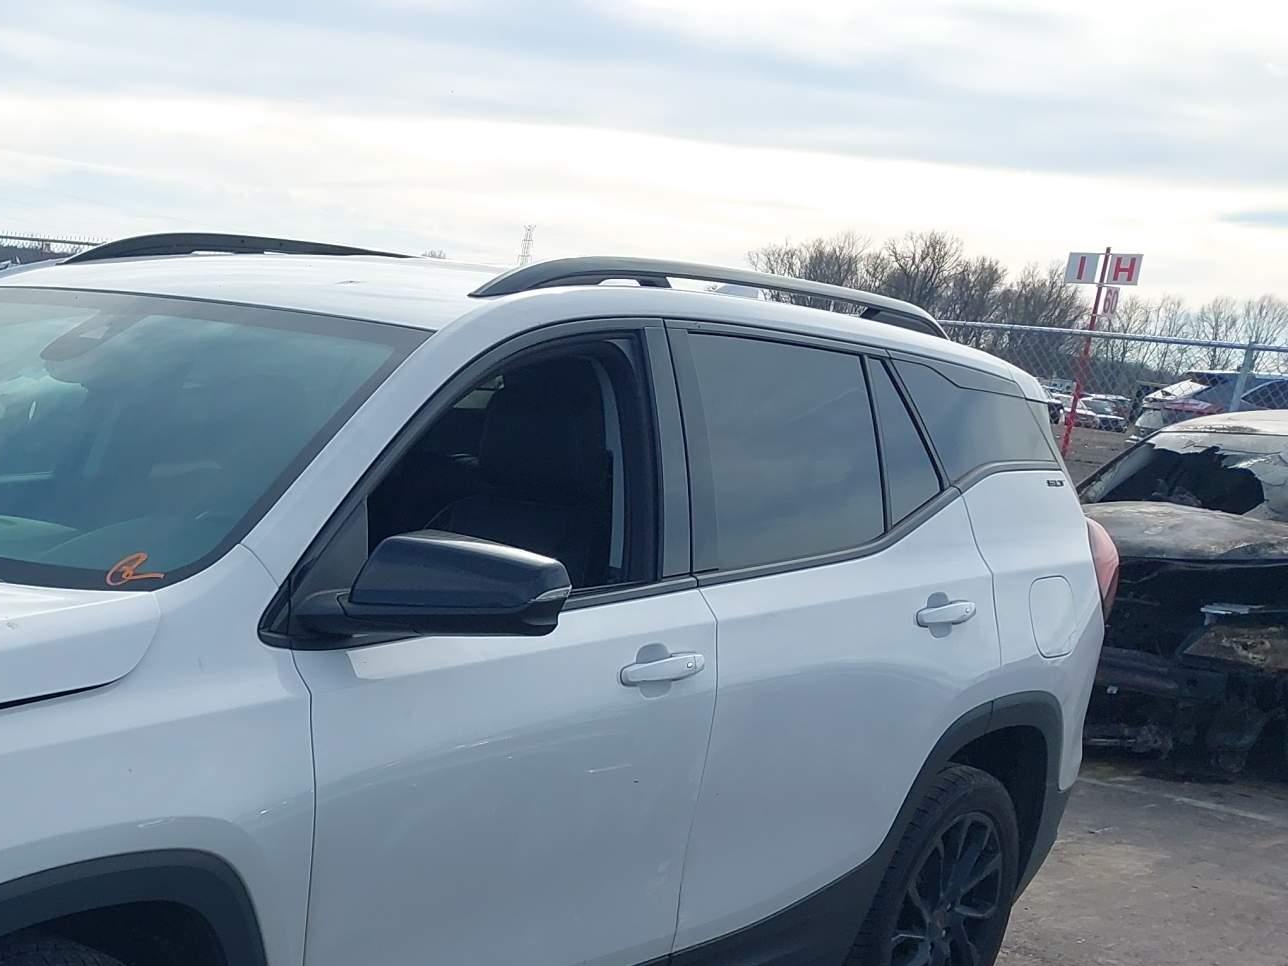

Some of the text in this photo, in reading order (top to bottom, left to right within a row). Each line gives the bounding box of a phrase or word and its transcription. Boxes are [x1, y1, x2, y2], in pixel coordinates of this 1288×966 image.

[1077, 256, 1086, 280] I
[1112, 257, 1136, 281] H
[1103, 288, 1119, 314] 60
